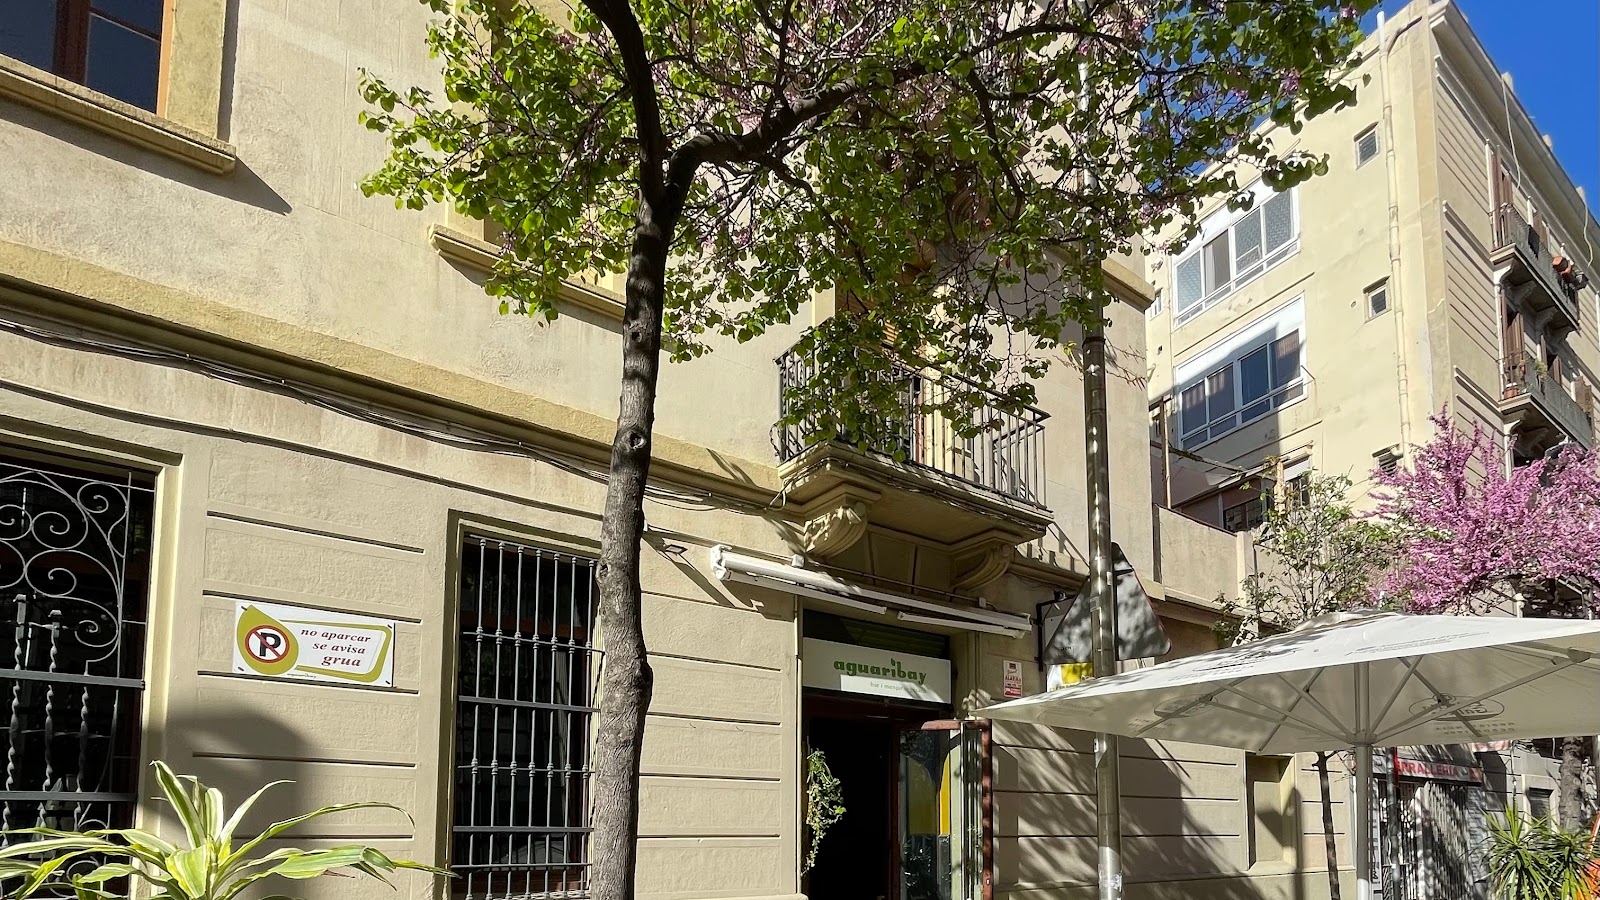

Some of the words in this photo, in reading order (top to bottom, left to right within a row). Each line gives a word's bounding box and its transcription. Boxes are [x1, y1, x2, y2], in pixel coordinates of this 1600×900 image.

[300, 628, 318, 637] no
[321, 631, 371, 643] aparcar
[312, 642, 328, 651] se
[331, 643, 366, 655] avisa
[321, 654, 361, 667] grua
[833, 657, 927, 686] aguaribay
